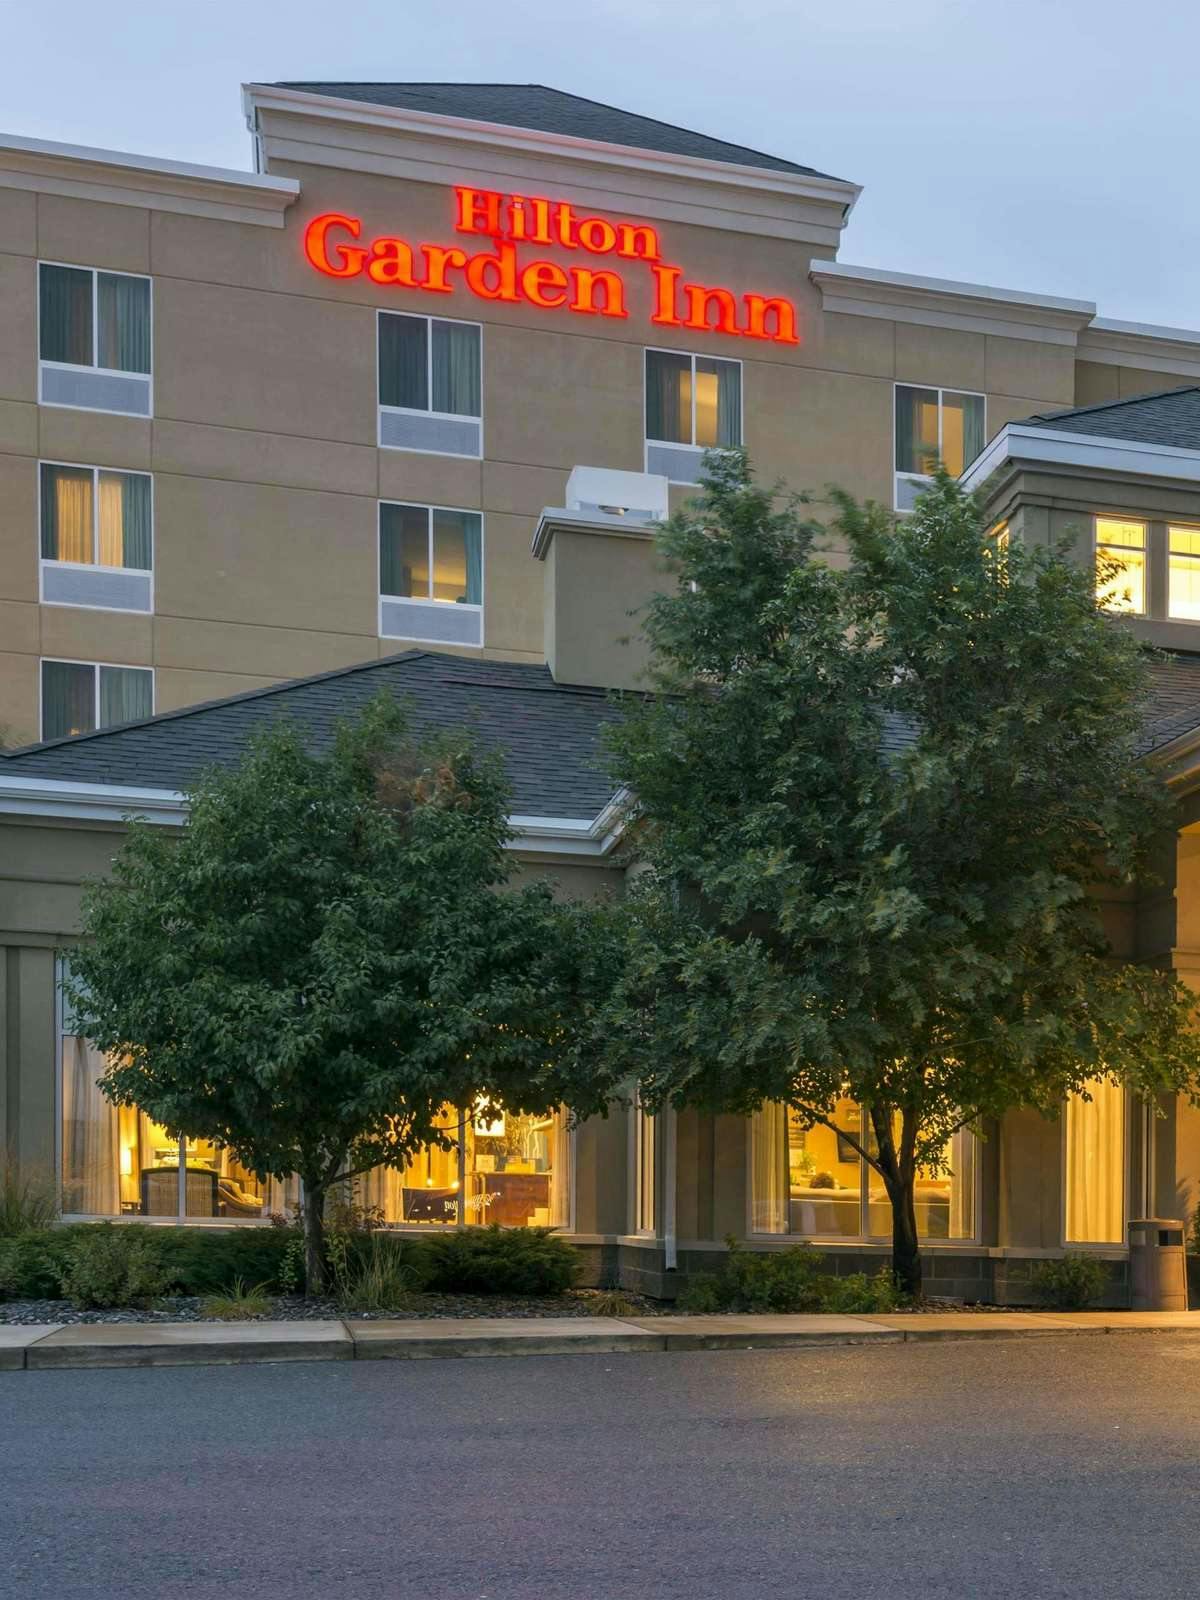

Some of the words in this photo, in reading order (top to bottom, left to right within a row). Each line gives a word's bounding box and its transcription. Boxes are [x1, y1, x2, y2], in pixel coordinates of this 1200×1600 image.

[455, 186, 662, 261] Hilton
[304, 213, 629, 318] Garden
[650, 263, 801, 344] Inn
